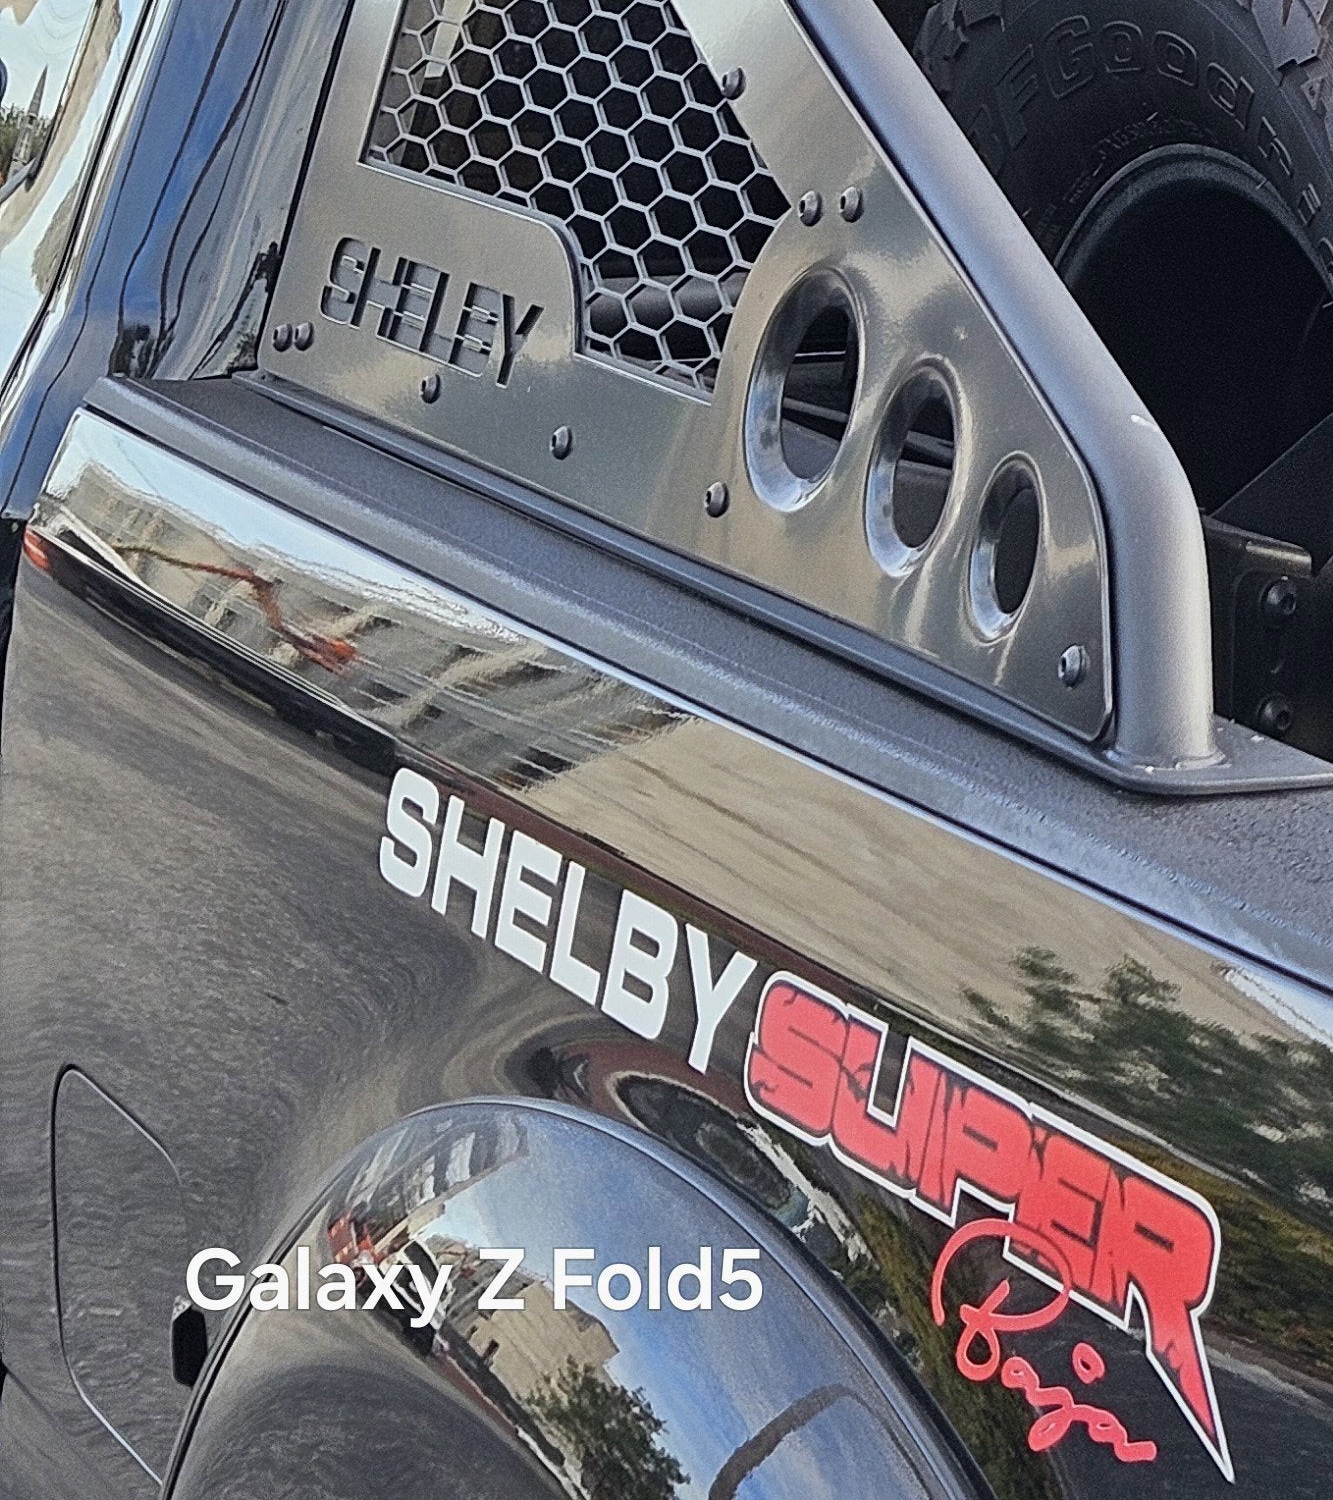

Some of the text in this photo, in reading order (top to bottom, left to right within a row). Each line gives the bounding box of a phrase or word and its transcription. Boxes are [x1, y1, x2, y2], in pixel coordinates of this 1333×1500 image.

[318, 237, 545, 389] SHELBY
[379, 766, 1234, 1483] SHELBY SUPER
[932, 1218, 1158, 1464] Baja
